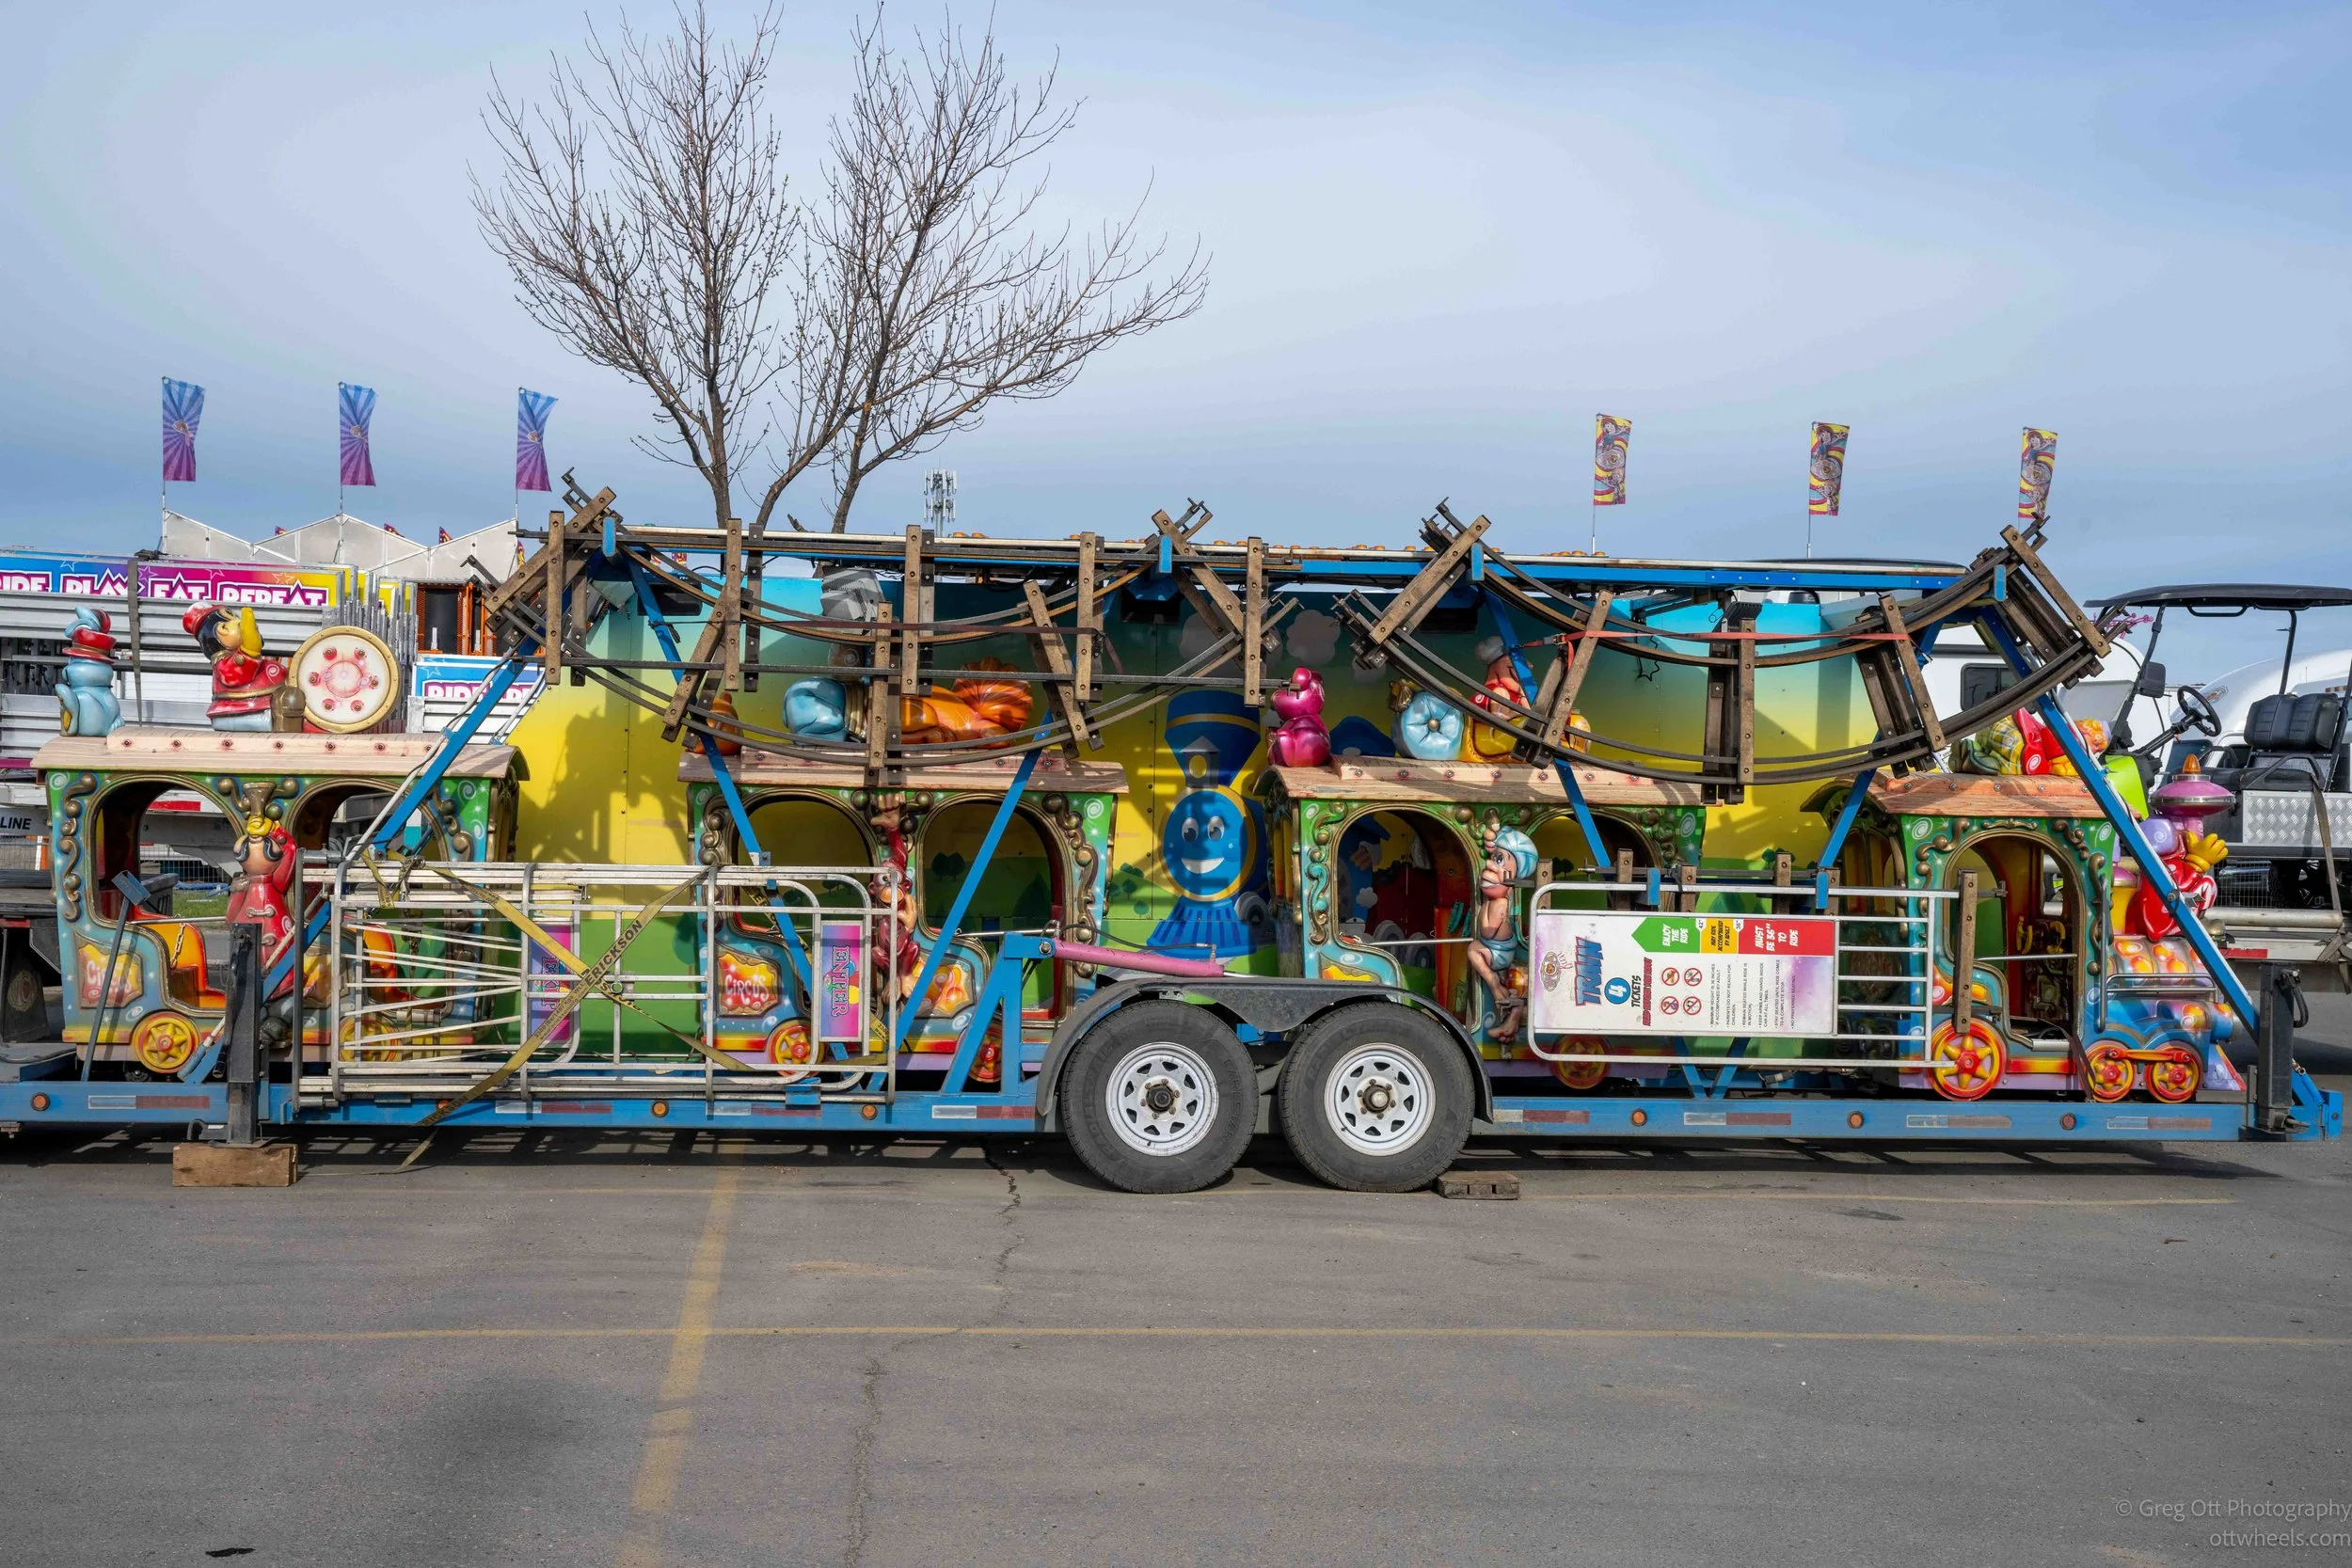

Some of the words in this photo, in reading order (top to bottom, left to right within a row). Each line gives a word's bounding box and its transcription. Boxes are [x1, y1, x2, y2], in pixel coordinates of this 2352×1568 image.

[0, 576, 46, 593] IDE
[154, 584, 205, 601] EAT
[1662, 924, 1671, 946] ENJOY
[1755, 926, 1764, 948] MUST
[1777, 932, 1787, 942] TO
[1789, 929, 1798, 946] RIDE
[584, 919, 643, 986] ERICKSON
[1766, 942, 1775, 951] BE
[832, 945, 850, 1017] ENTER
[1574, 936, 1603, 1006] TRAIN
[1608, 985, 1627, 997] 4
[1631, 975, 1641, 1007] TICKETS
